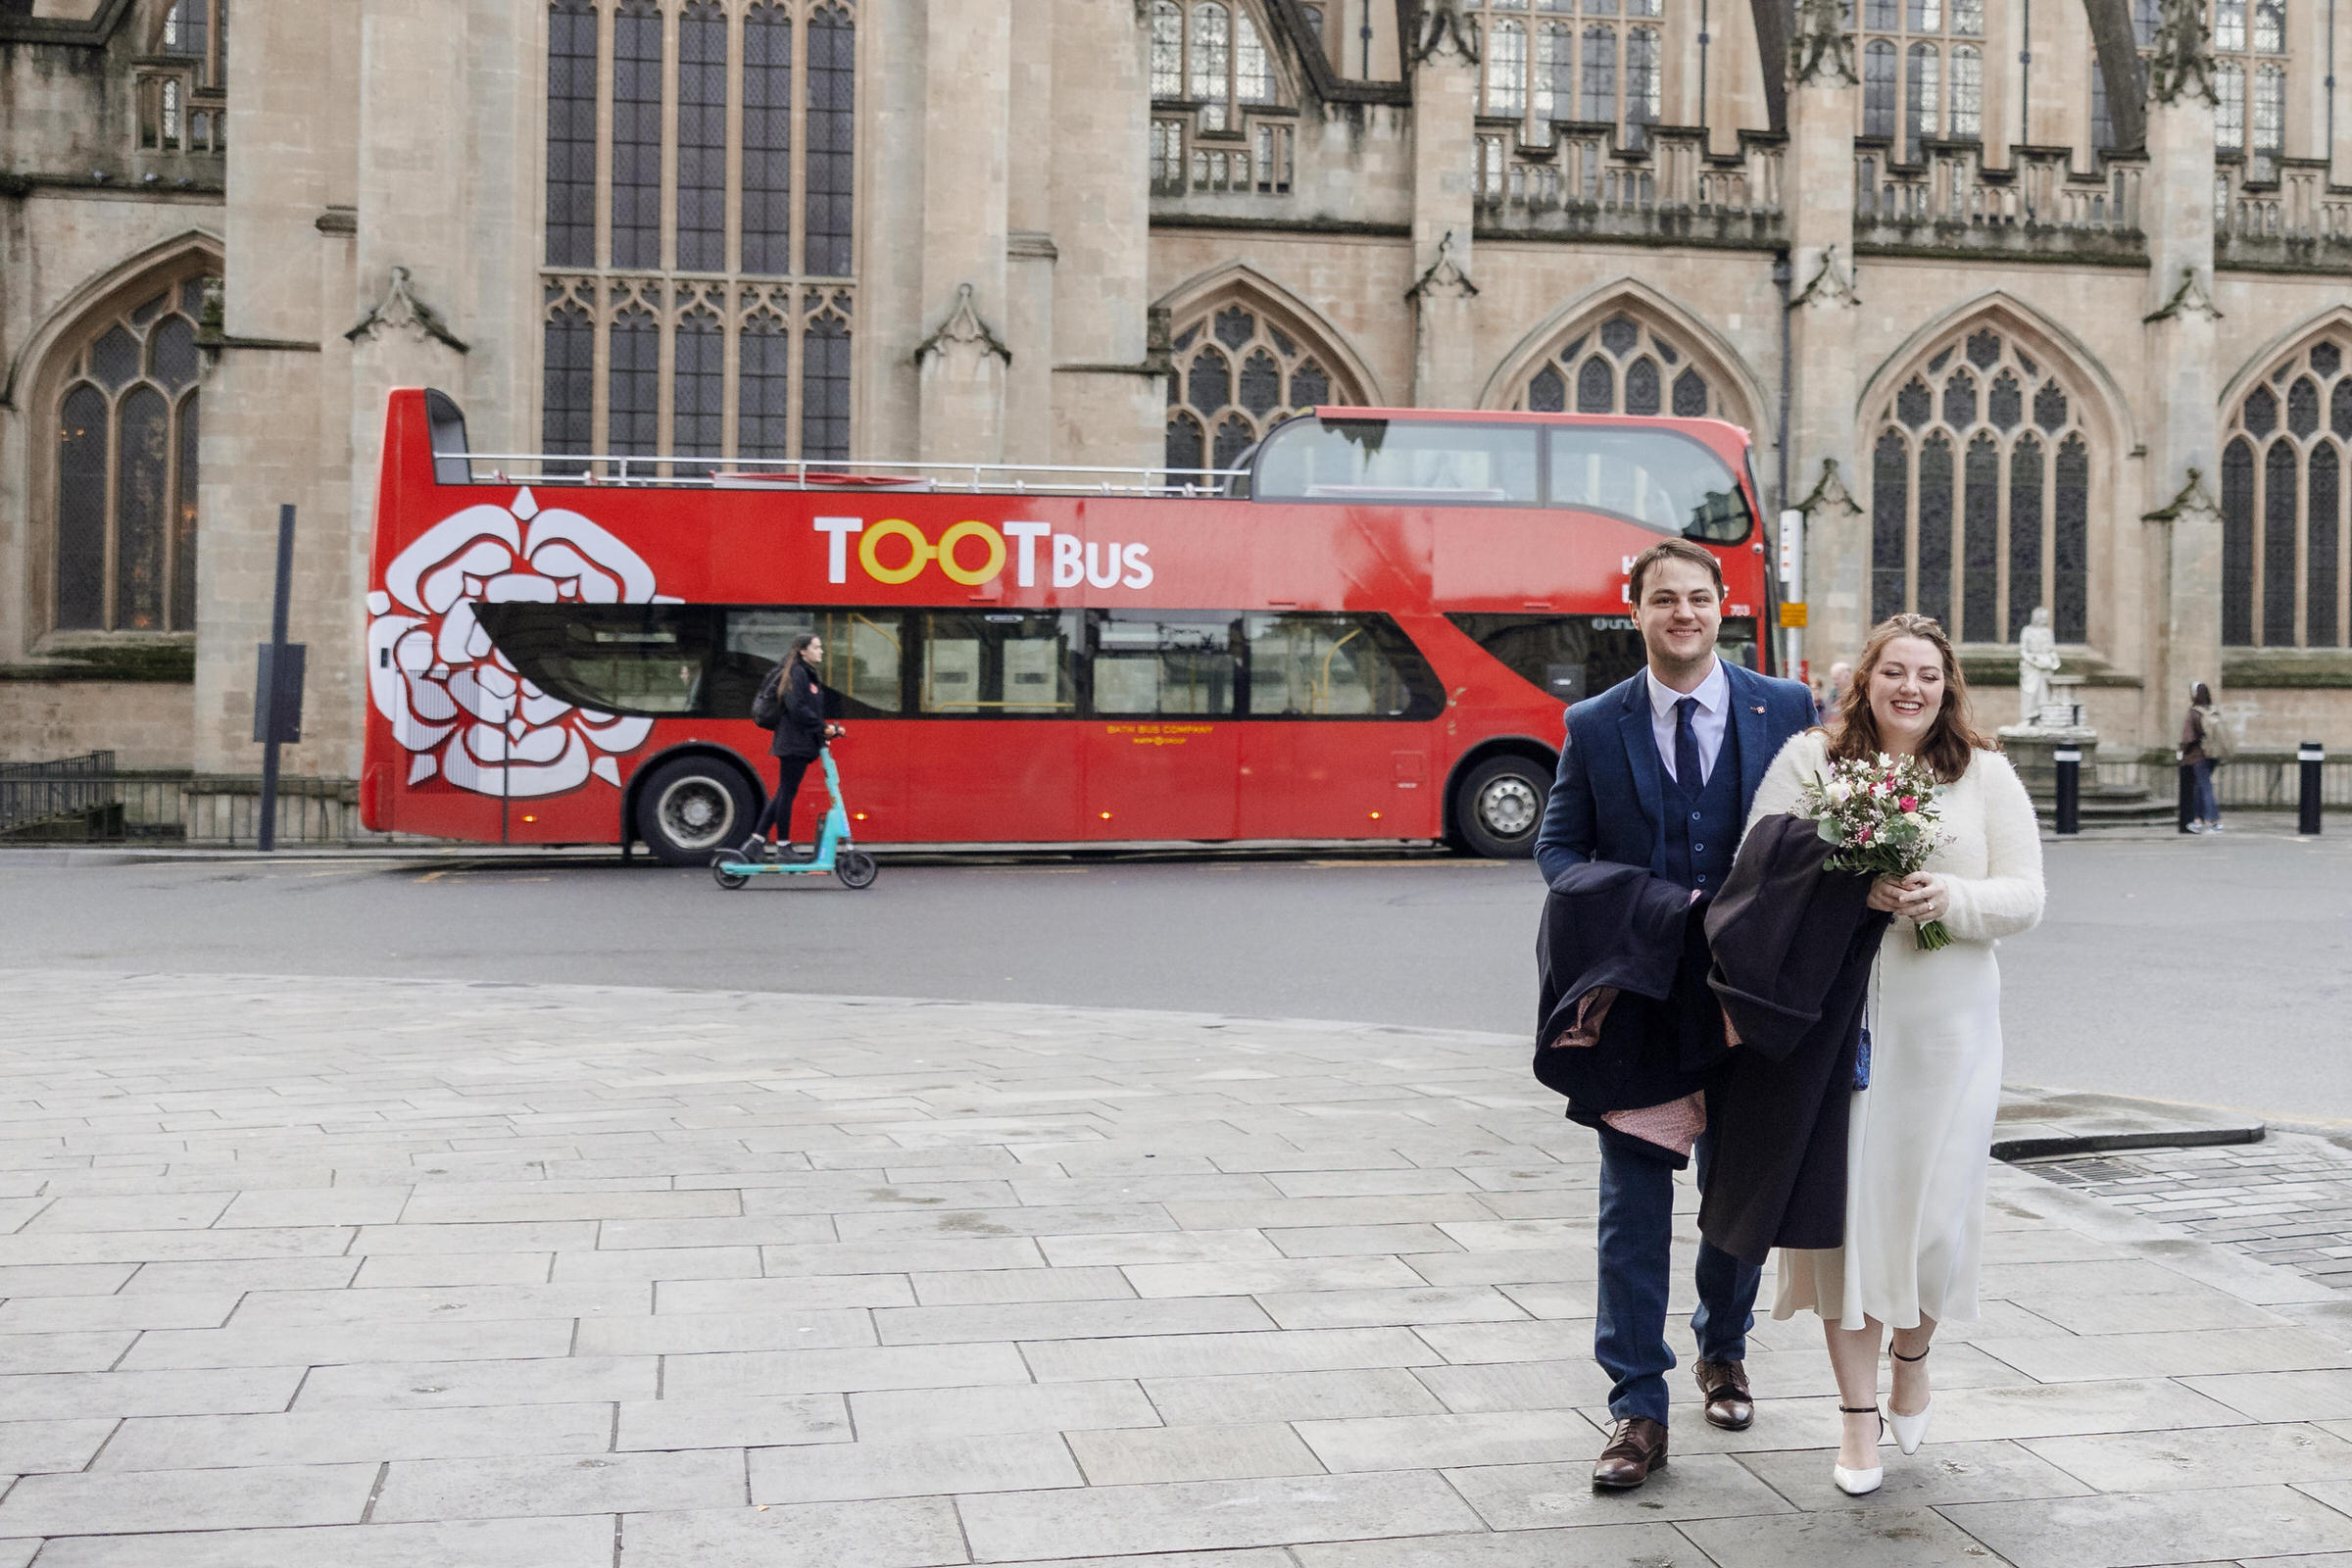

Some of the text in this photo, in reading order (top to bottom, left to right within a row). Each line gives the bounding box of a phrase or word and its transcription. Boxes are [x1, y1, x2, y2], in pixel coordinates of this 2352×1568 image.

[1106, 724, 1214, 734] BATH BUS COMPANY
